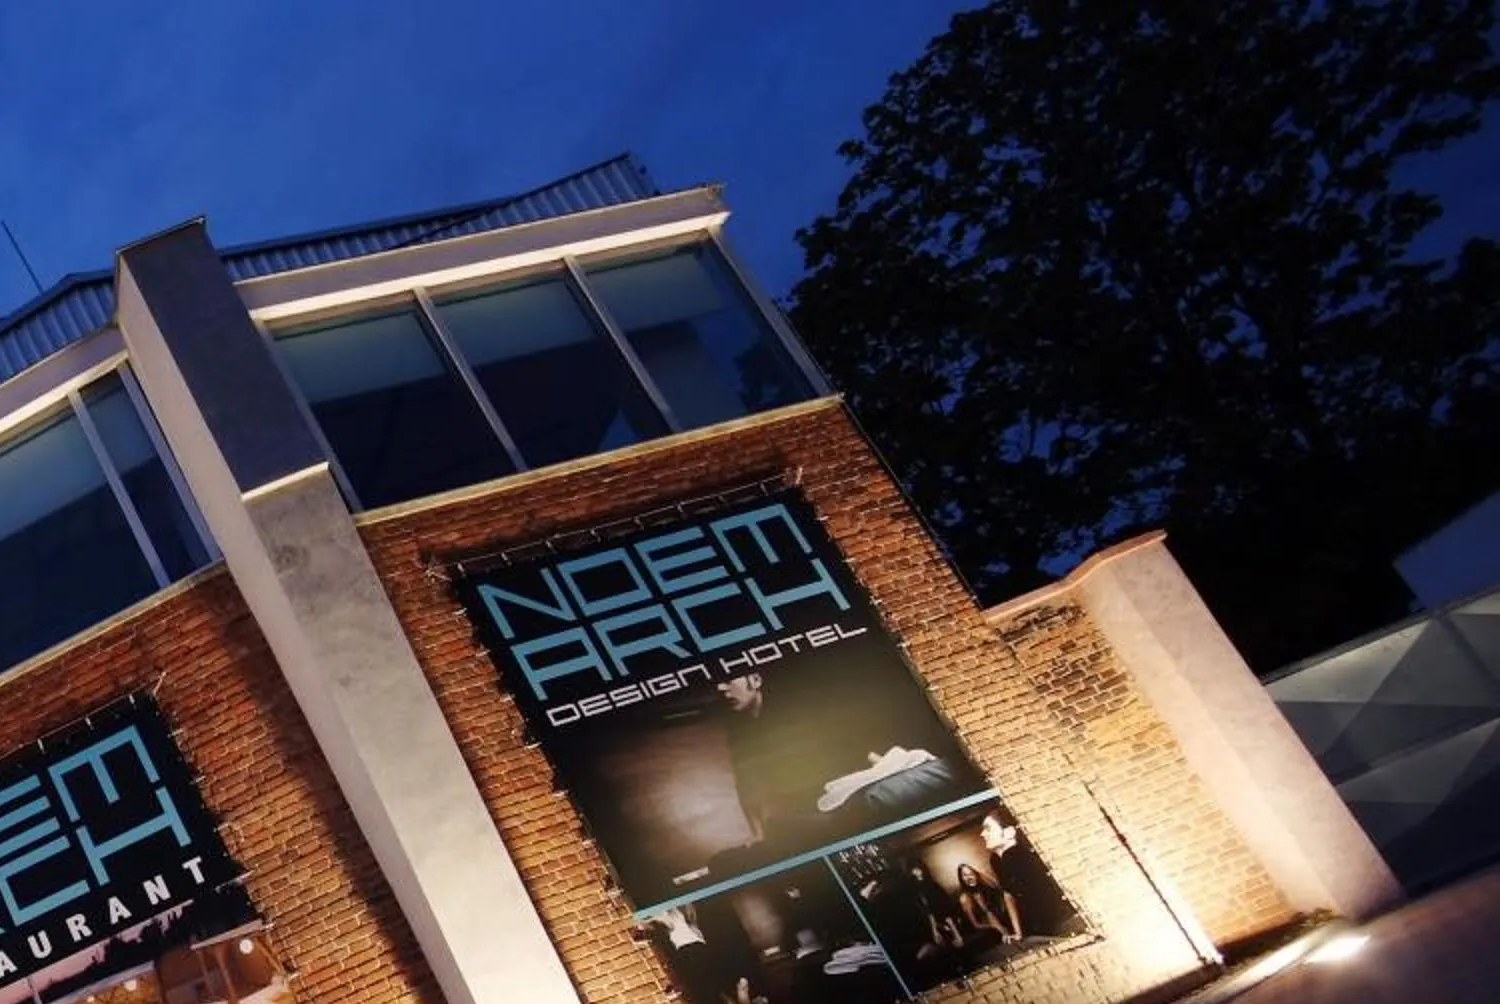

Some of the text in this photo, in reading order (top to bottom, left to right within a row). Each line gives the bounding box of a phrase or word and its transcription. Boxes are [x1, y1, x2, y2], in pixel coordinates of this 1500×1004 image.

[476, 503, 813, 640] NOEM
[510, 557, 851, 701] ARCH
[545, 622, 868, 728] DESIGN HOTEL
